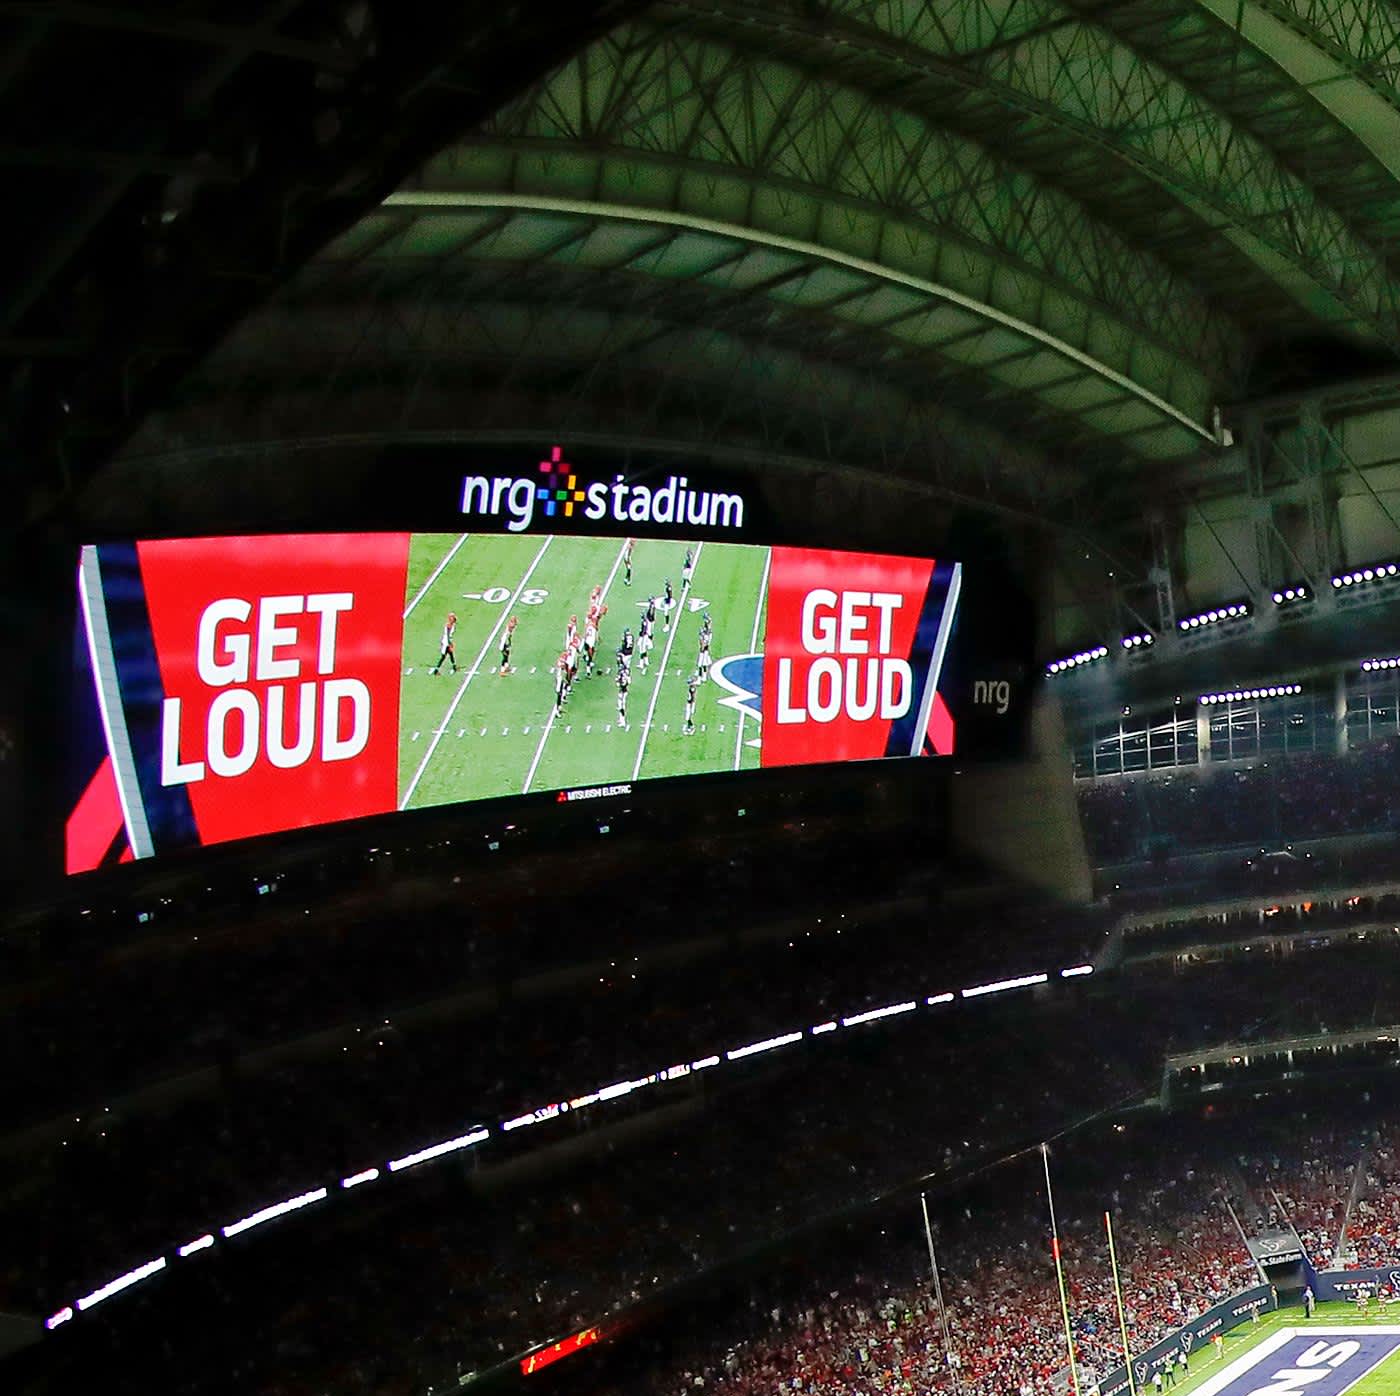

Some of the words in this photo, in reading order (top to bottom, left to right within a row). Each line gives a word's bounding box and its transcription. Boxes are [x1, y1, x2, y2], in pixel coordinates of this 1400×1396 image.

[461, 475, 536, 532] nrg
[584, 474, 744, 528] stadium
[196, 591, 355, 687] GET
[801, 588, 903, 655] GET
[776, 656, 913, 725] LOUD
[974, 678, 1010, 714] nrg
[160, 677, 372, 787] LOUD
[1196, 1318, 1224, 1339] TEXANS
